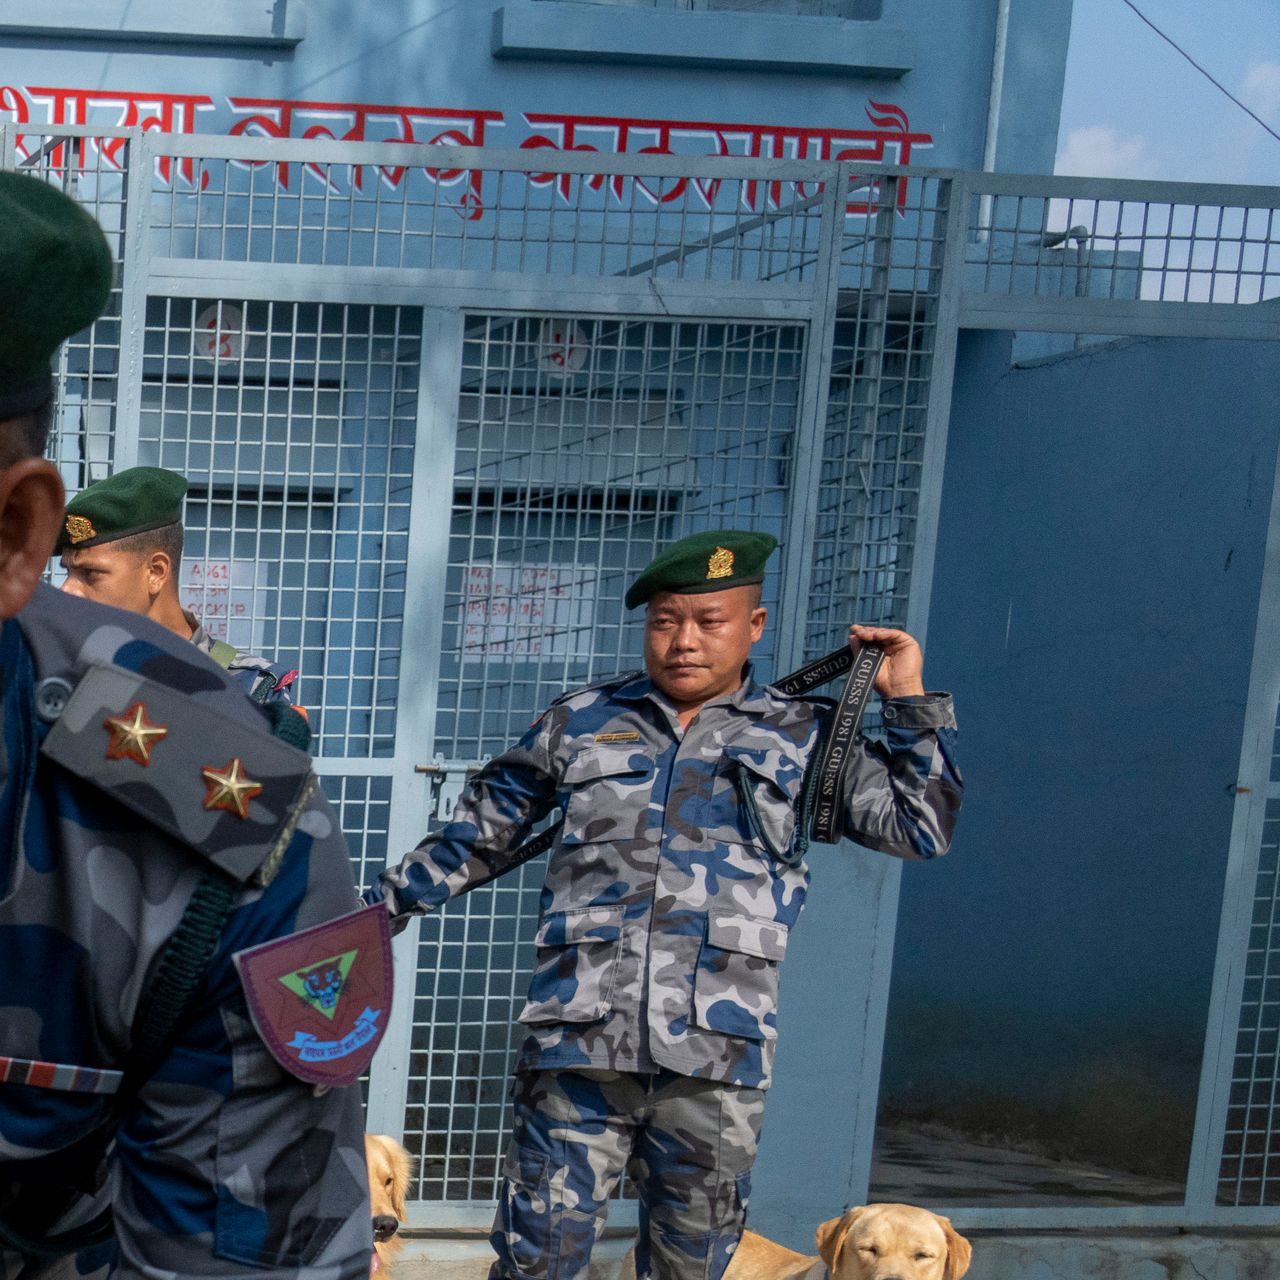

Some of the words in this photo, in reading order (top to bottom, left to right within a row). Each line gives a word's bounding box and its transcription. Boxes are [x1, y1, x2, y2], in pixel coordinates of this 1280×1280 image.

[803, 655, 851, 685] GUESS
[847, 658, 873, 705] GUESS
[836, 711, 855, 741] 1981
[822, 746, 843, 796] GUESS
[818, 802, 832, 830] 1981
